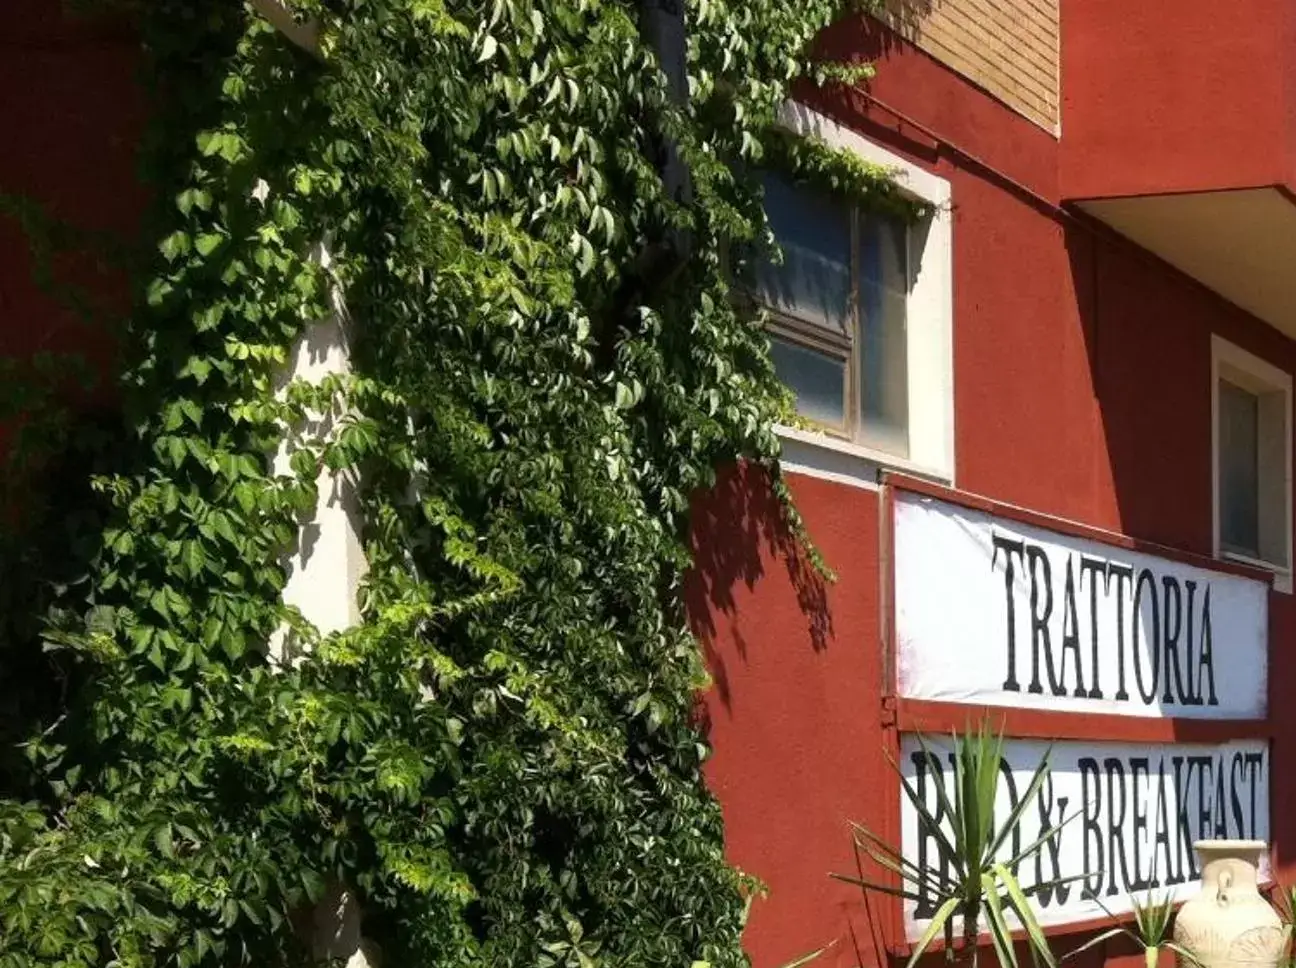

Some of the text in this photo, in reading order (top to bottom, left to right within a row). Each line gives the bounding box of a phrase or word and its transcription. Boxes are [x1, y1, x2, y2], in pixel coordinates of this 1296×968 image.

[991, 534, 1219, 705] TRATTORIA
[911, 751, 1262, 919] BD & BREAKFAST
